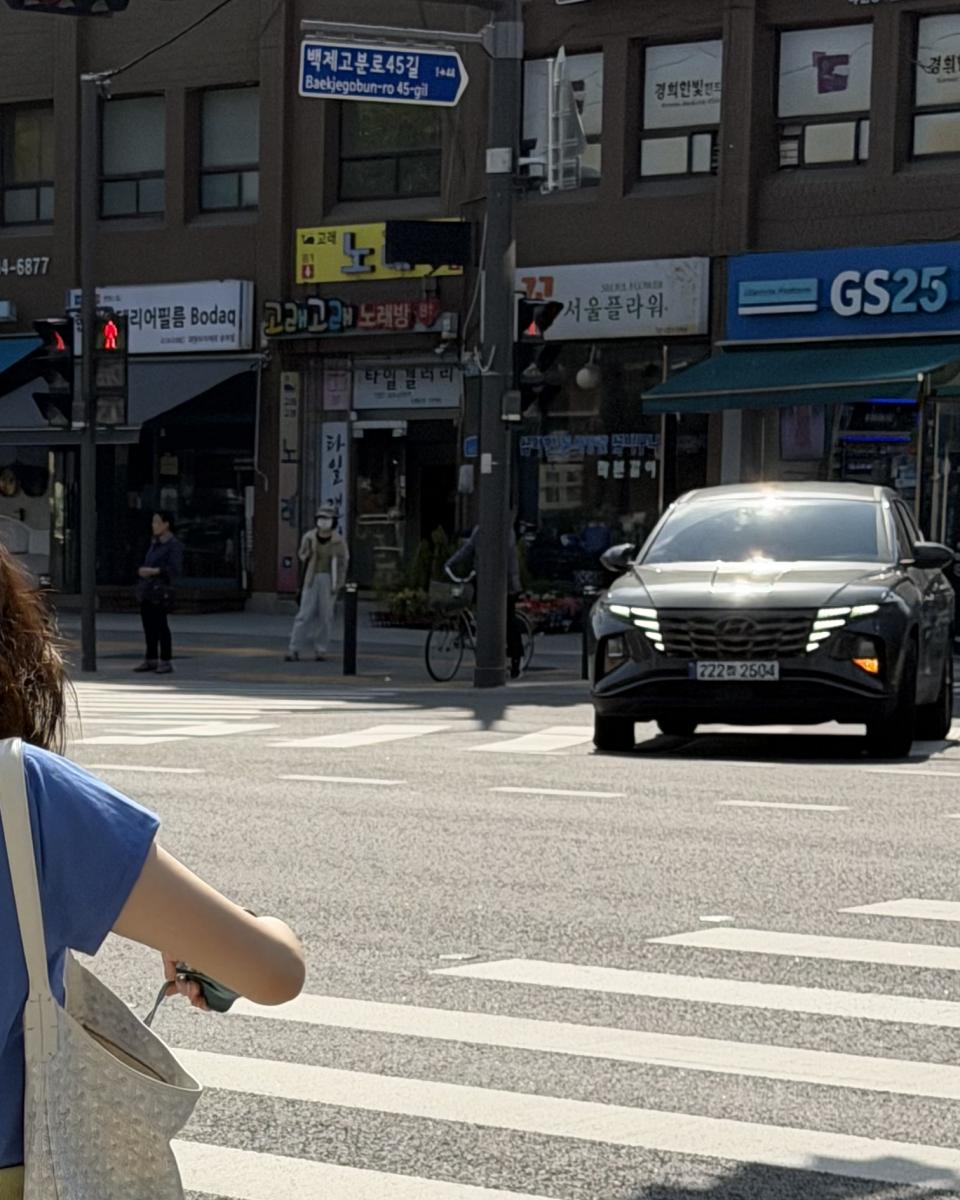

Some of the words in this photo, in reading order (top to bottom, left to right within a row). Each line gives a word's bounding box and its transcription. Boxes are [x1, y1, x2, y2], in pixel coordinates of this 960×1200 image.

[306, 47, 420, 79] 백제고분로45길
[926, 54, 960, 75] 경희
[305, 75, 394, 95] Baekjegobun-ro
[397, 82, 429, 99] 45-gil
[317, 231, 337, 245] 고래
[830, 265, 948, 317] GS25
[191, 305, 236, 327] Bodaq
[263, 297, 354, 335] 고래고래
[358, 303, 411, 328] 노래방
[563, 292, 664, 322] 서울플라워
[365, 367, 397, 391] 타일
